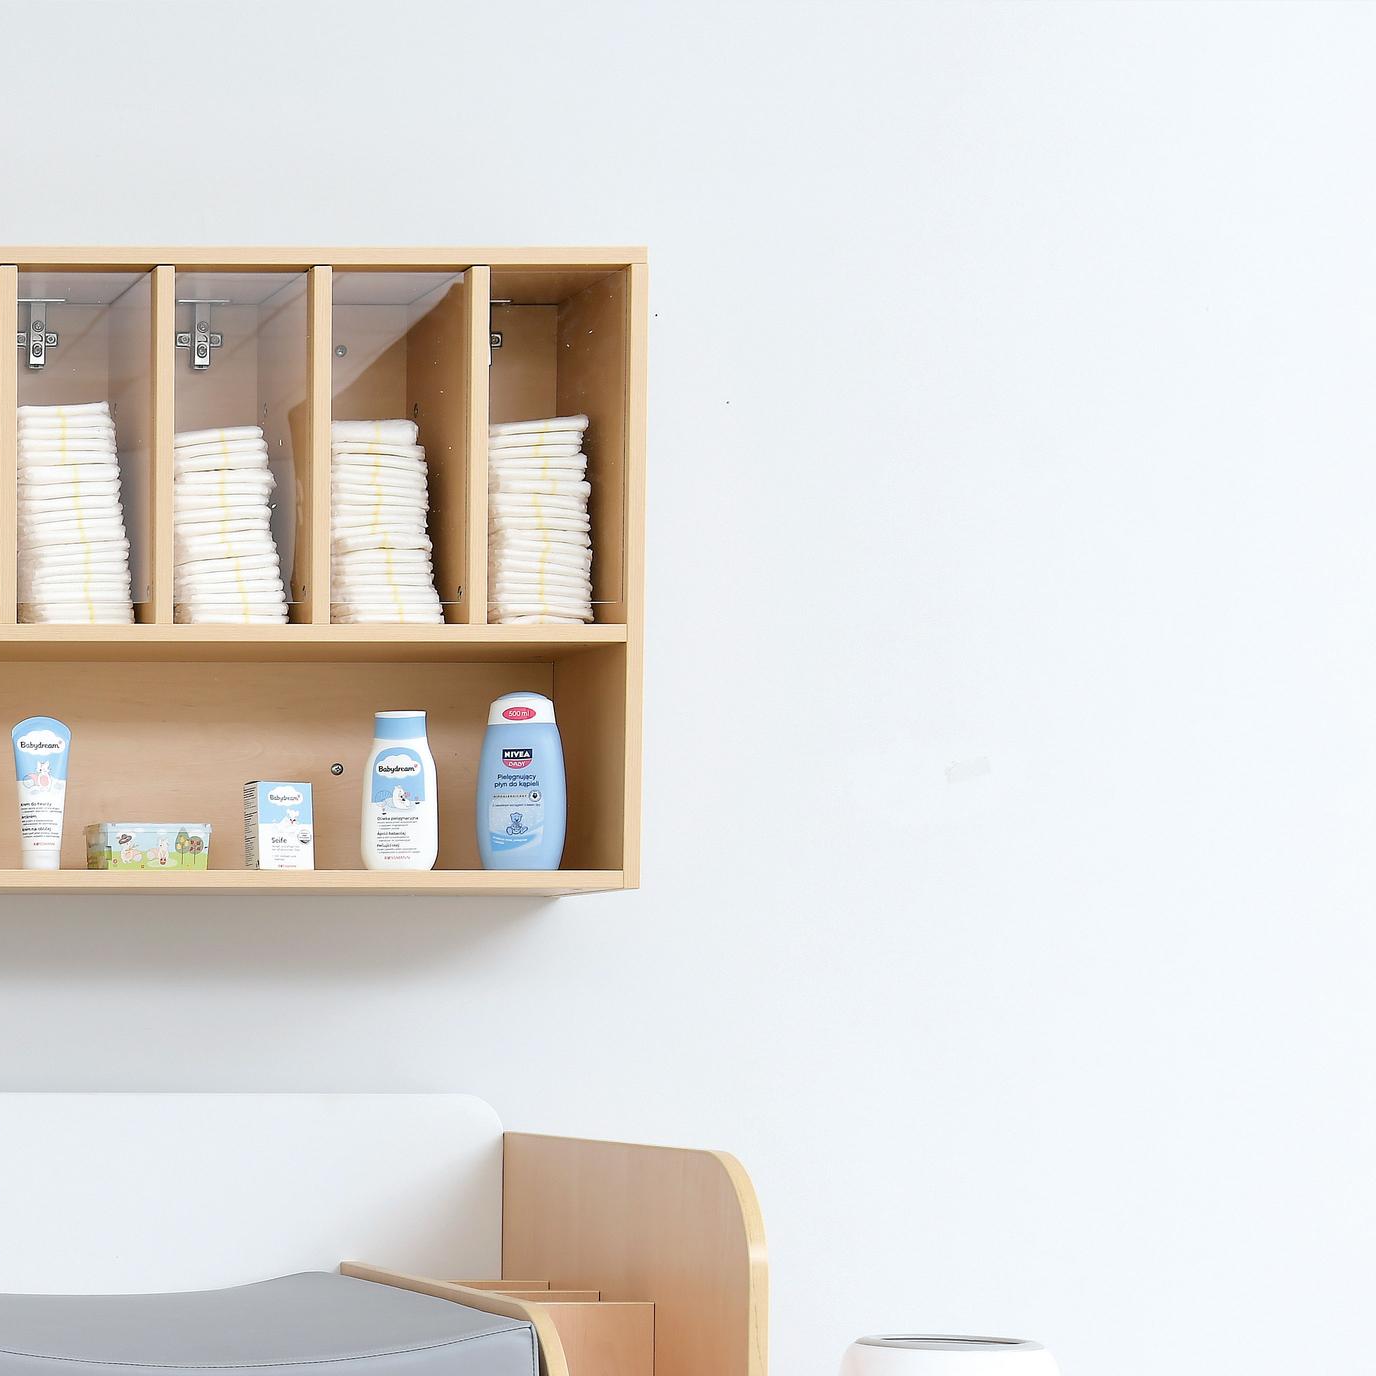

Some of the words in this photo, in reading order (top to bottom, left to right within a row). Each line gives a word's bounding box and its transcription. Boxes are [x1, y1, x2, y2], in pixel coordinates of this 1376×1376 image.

[20, 741, 60, 751] Babydream
[504, 750, 530, 758] NIVEA
[378, 765, 415, 774] Babydream
